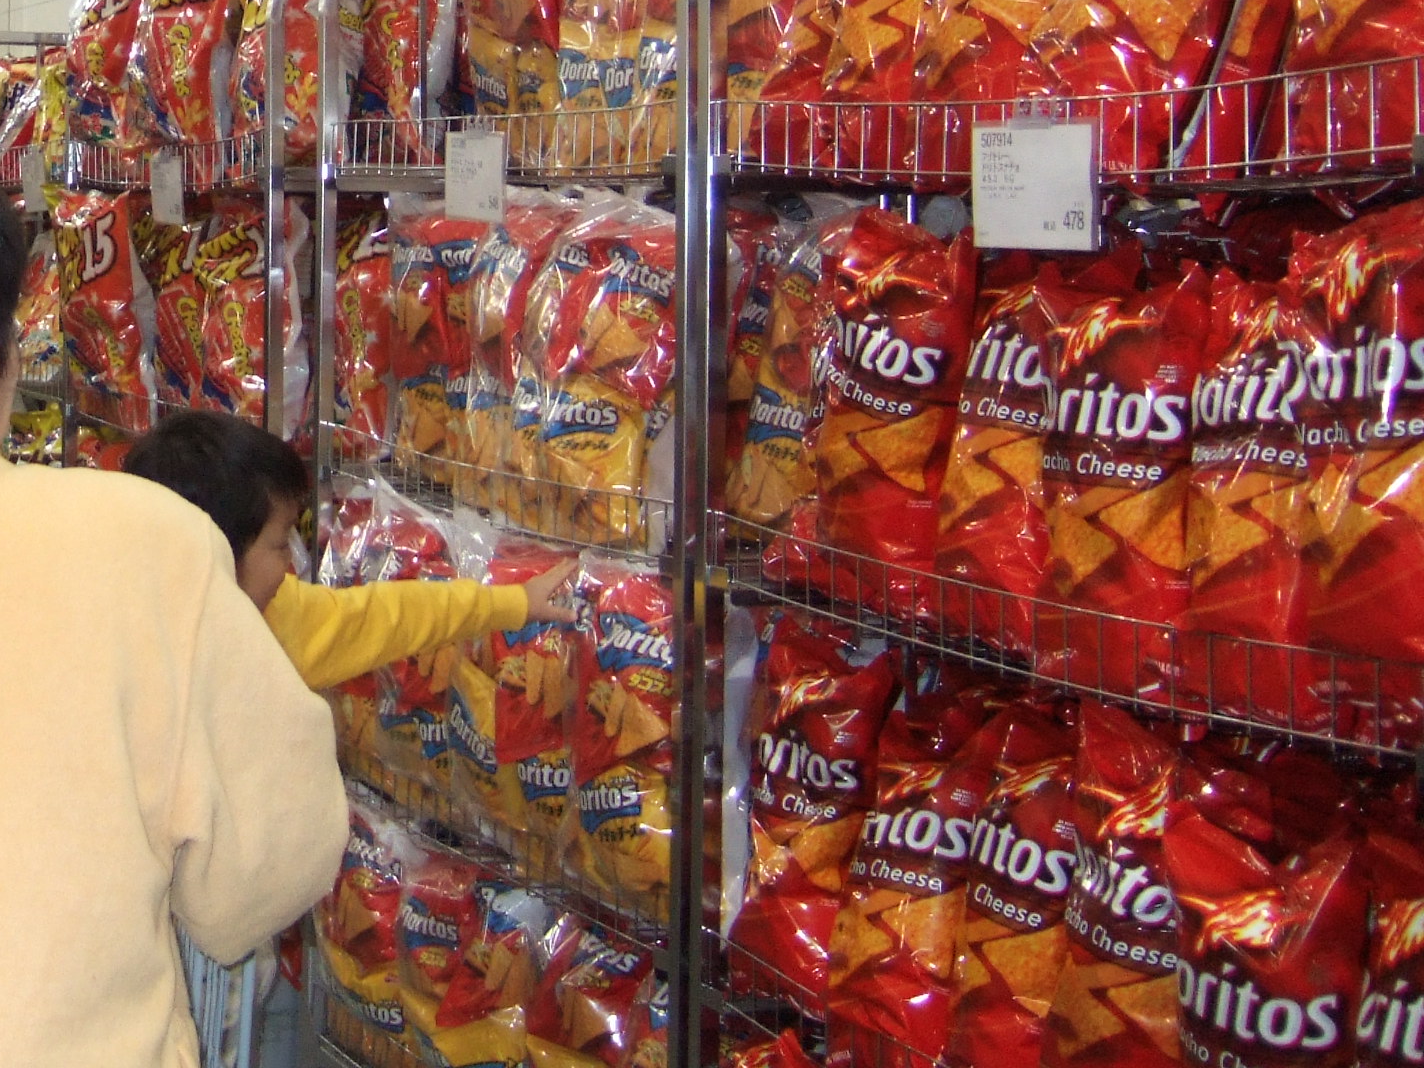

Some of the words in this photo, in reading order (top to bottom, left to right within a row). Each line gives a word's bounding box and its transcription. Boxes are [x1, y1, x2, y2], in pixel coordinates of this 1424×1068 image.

[980, 132, 1013, 148] 507914
[1062, 210, 1085, 231] 478
[82, 211, 117, 282] 15
[842, 379, 913, 417] Cheese
[1075, 453, 1163, 481] Cheese
[870, 857, 942, 893] Cheese
[974, 883, 1043, 928] Cheese
[1091, 925, 1177, 969] Cheese
